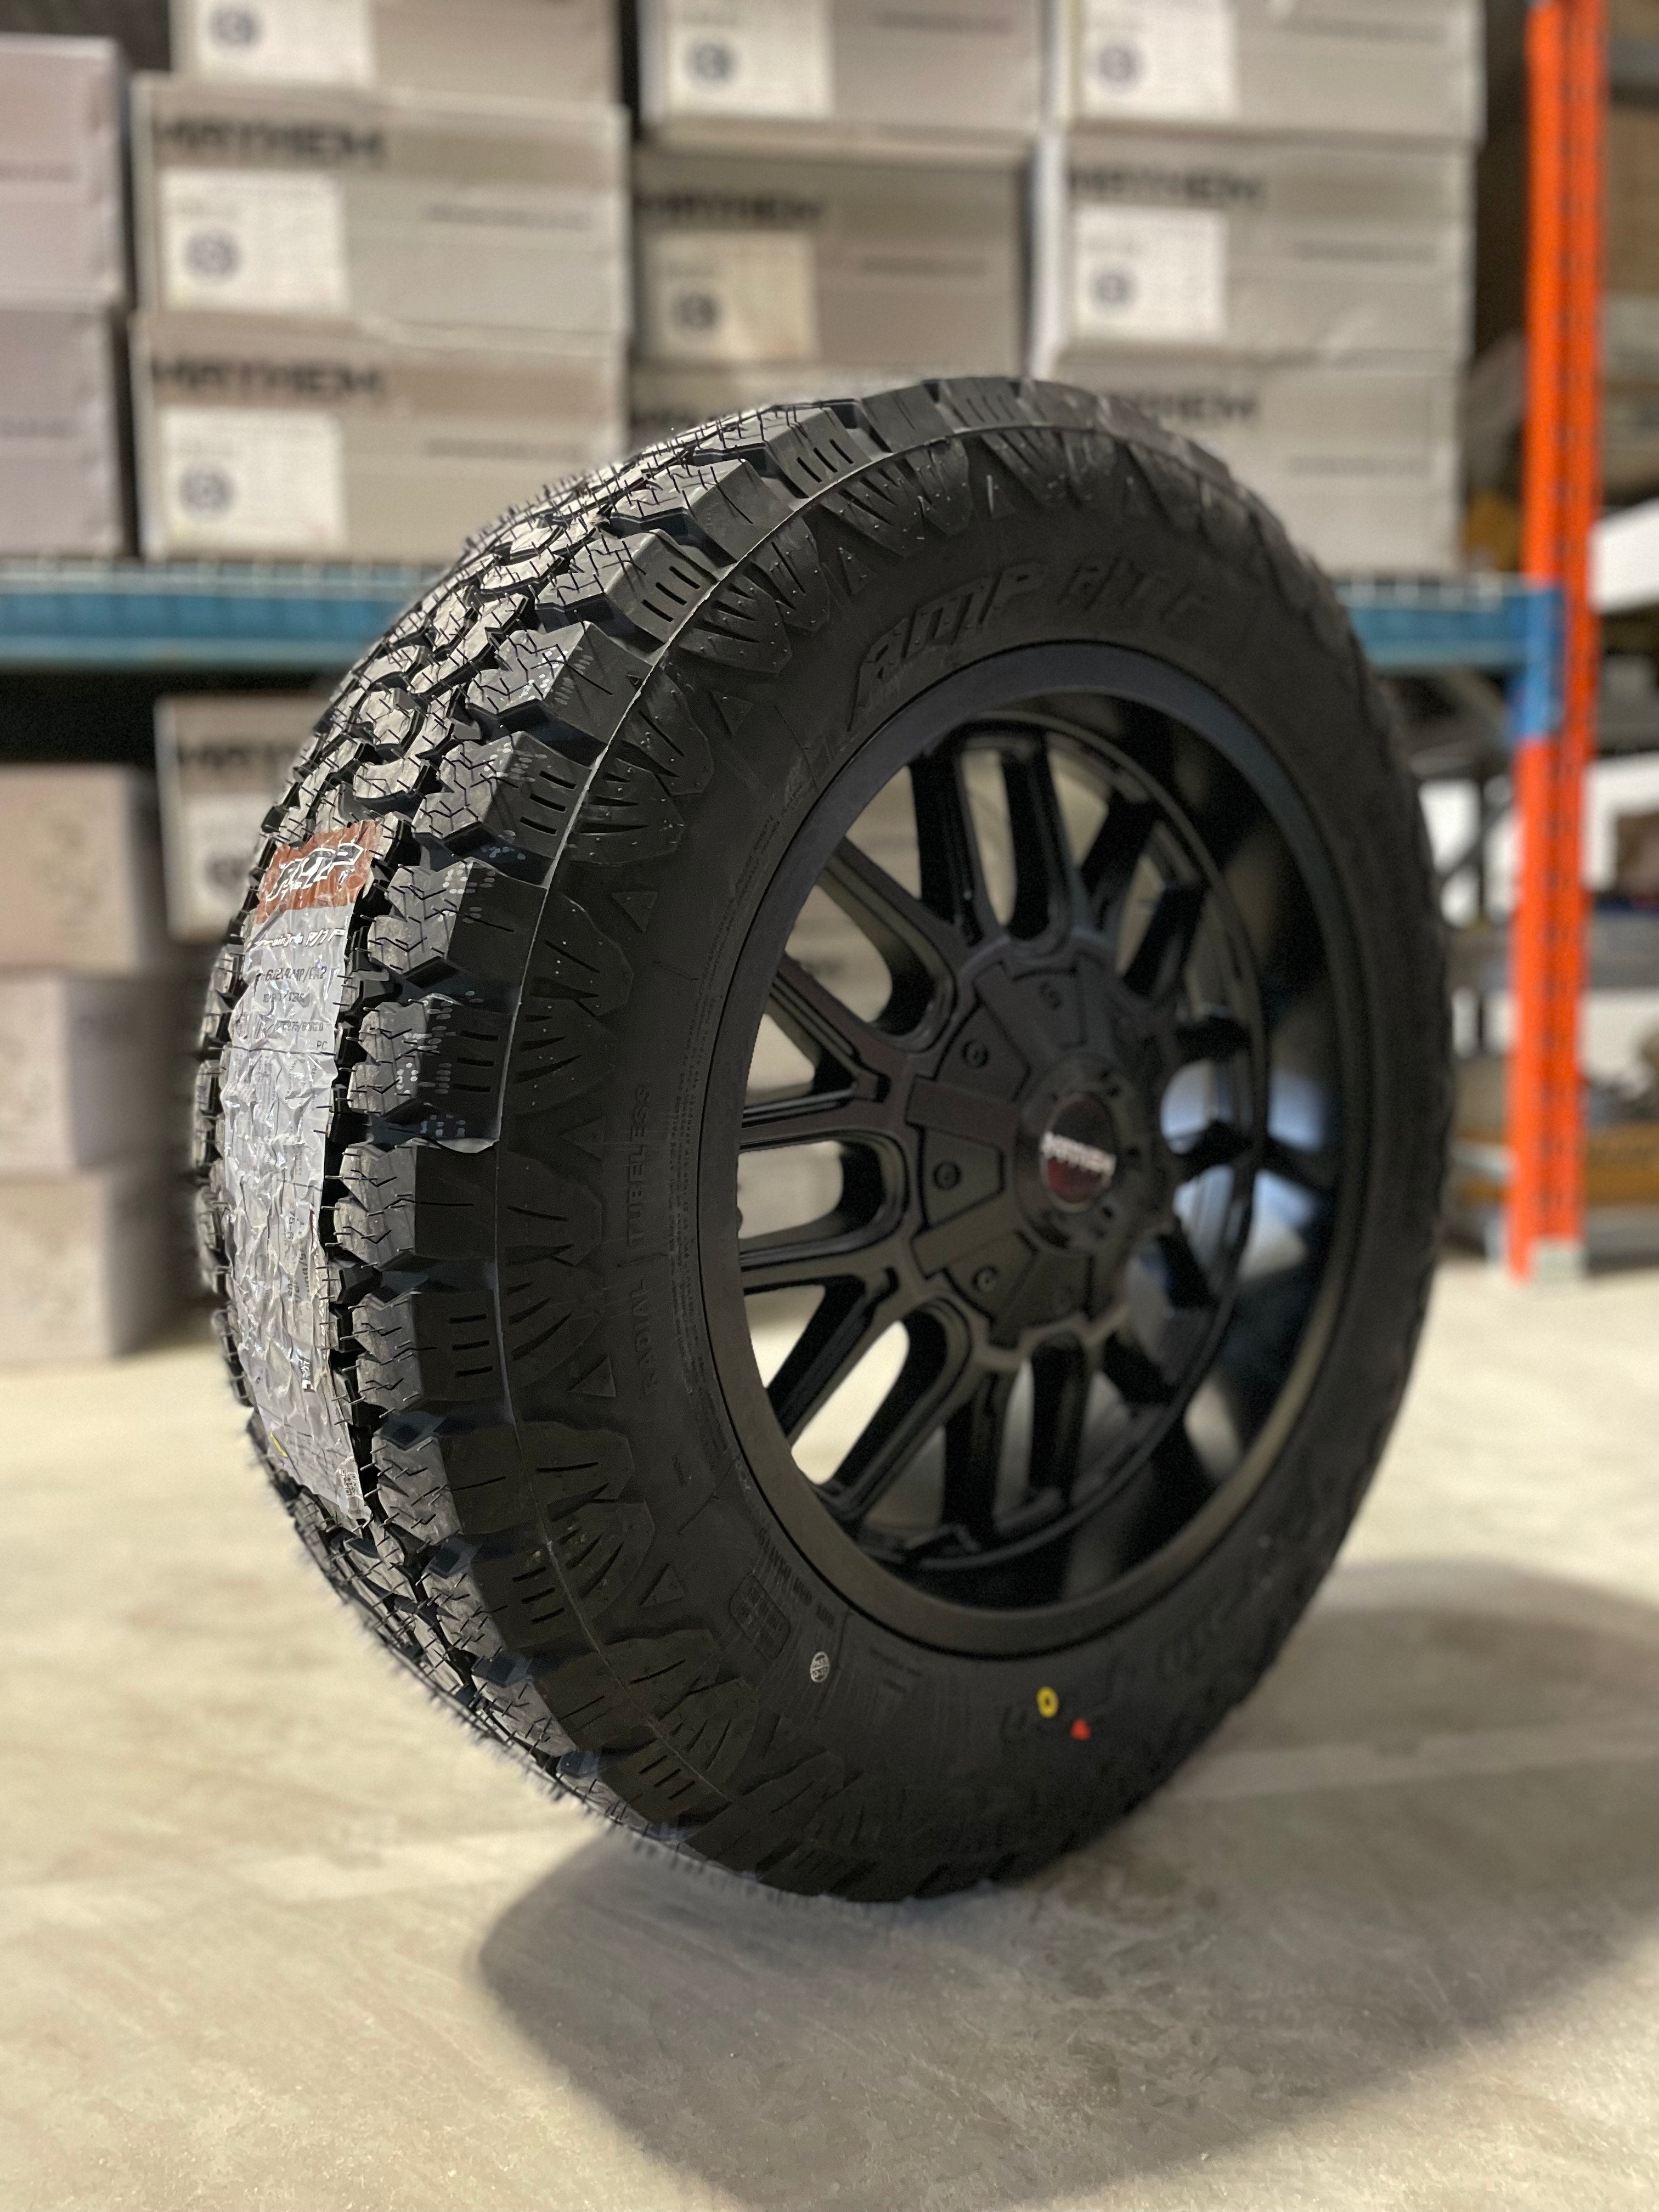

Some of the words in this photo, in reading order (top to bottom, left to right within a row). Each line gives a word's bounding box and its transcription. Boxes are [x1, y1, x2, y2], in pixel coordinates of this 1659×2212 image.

[316, 1040, 328, 1051] PC
[627, 1084, 650, 1246] TUBELESS
[630, 1278, 658, 1398] RADIAL
